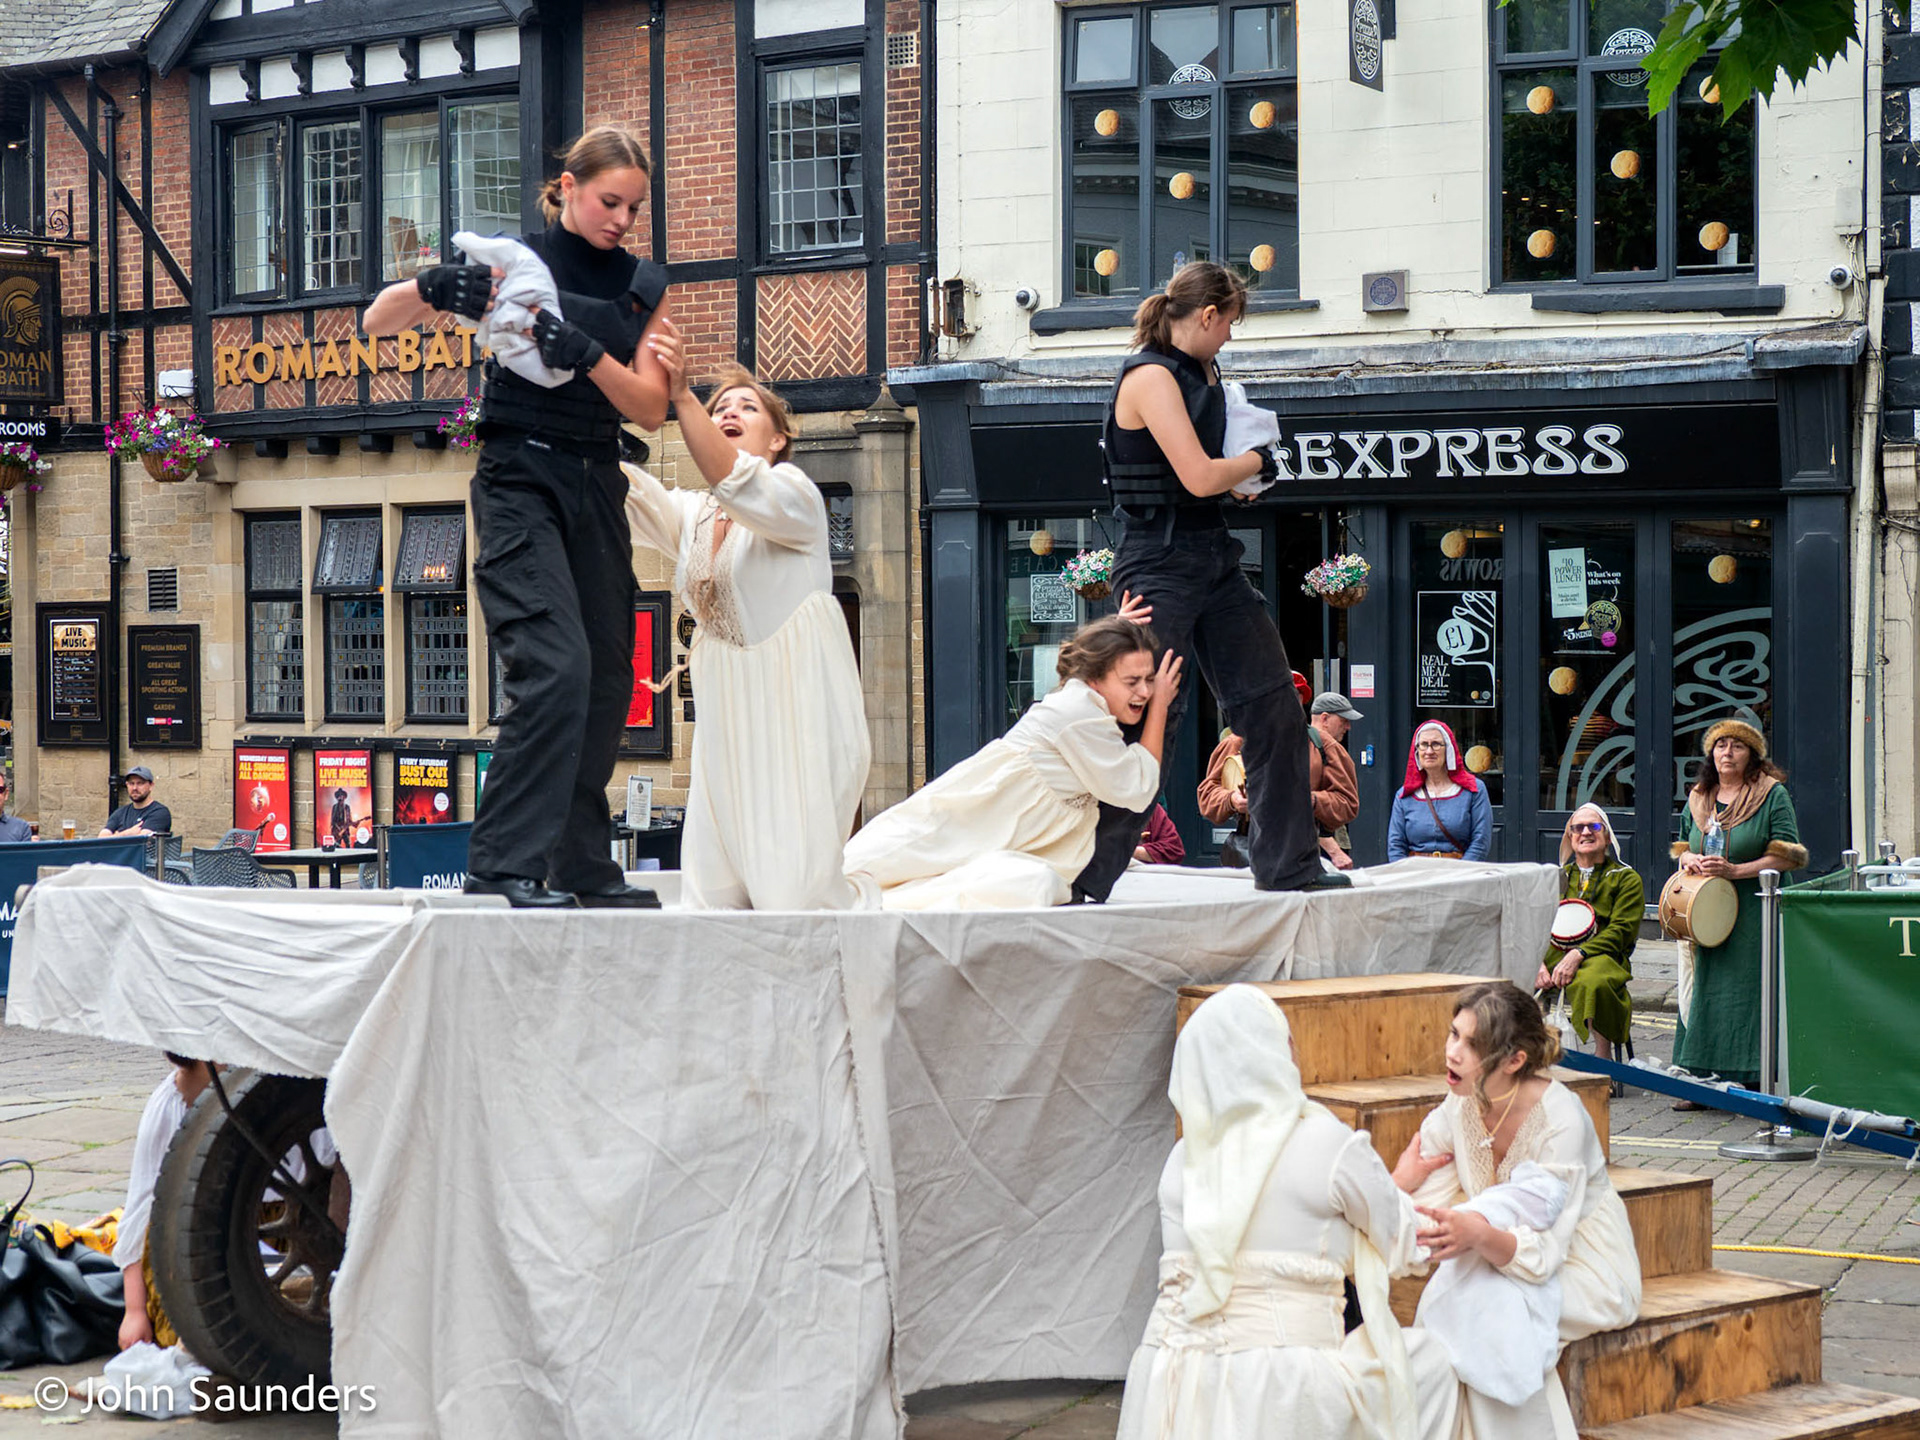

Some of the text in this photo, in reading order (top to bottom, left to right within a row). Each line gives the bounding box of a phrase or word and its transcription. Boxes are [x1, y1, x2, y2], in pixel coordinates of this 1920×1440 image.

[0, 350, 52, 373] OMAN
[217, 325, 493, 387] ROMAN BAT
[0, 371, 40, 386] BATH
[1294, 424, 1629, 480] EXPRESS
[1554, 565, 1582, 575] POWER
[1555, 574, 1582, 583] LUNCH
[65, 627, 82, 636] LIVE
[61, 638, 87, 648] MUSIC
[1445, 625, 1465, 650] £1
[147, 661, 181, 669] GREAT VALUE
[1421, 654, 1449, 666] REAL.
[1421, 676, 1449, 688] DEAL.
[239, 762, 285, 772] ALL SINGING
[319, 757, 367, 766] FRIDAY NIGHT
[400, 757, 448, 767] EVERY SATURDAY
[238, 771, 286, 781] ALL DANCING
[319, 768, 368, 779] LIVE MUSIC
[400, 765, 448, 779] BUST OUT
[400, 777, 448, 788] SOME MOVES
